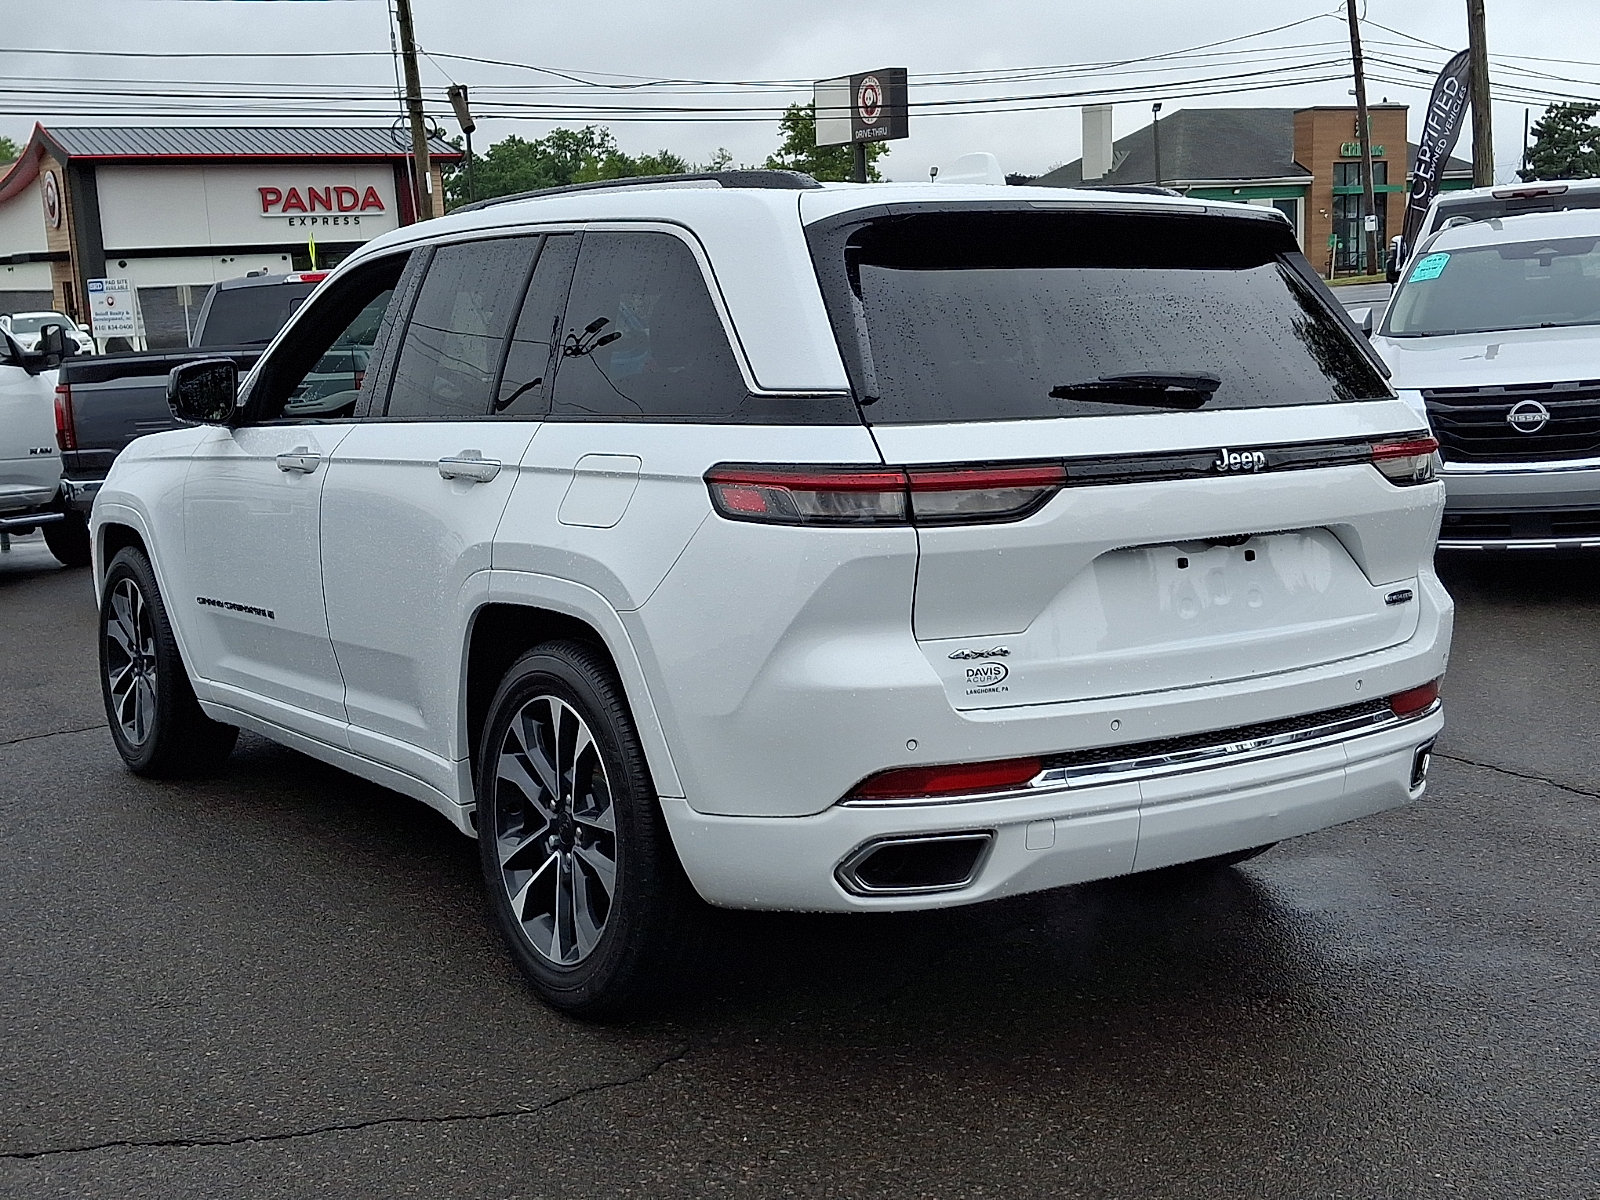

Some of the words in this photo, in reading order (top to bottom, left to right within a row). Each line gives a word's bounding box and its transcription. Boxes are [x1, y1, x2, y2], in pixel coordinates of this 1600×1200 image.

[1443, 85, 1467, 136] VEHICLES
[855, 126, 888, 139] DRIVE-THRU
[1412, 76, 1459, 200] CERTIFIED
[258, 186, 385, 213] PANDA
[288, 216, 360, 227] EXPRESS
[1507, 412, 1550, 422] NISSAN
[1215, 448, 1265, 472] Jeep
[966, 666, 1001, 678] DAVIS
[966, 675, 999, 683] ACURA
